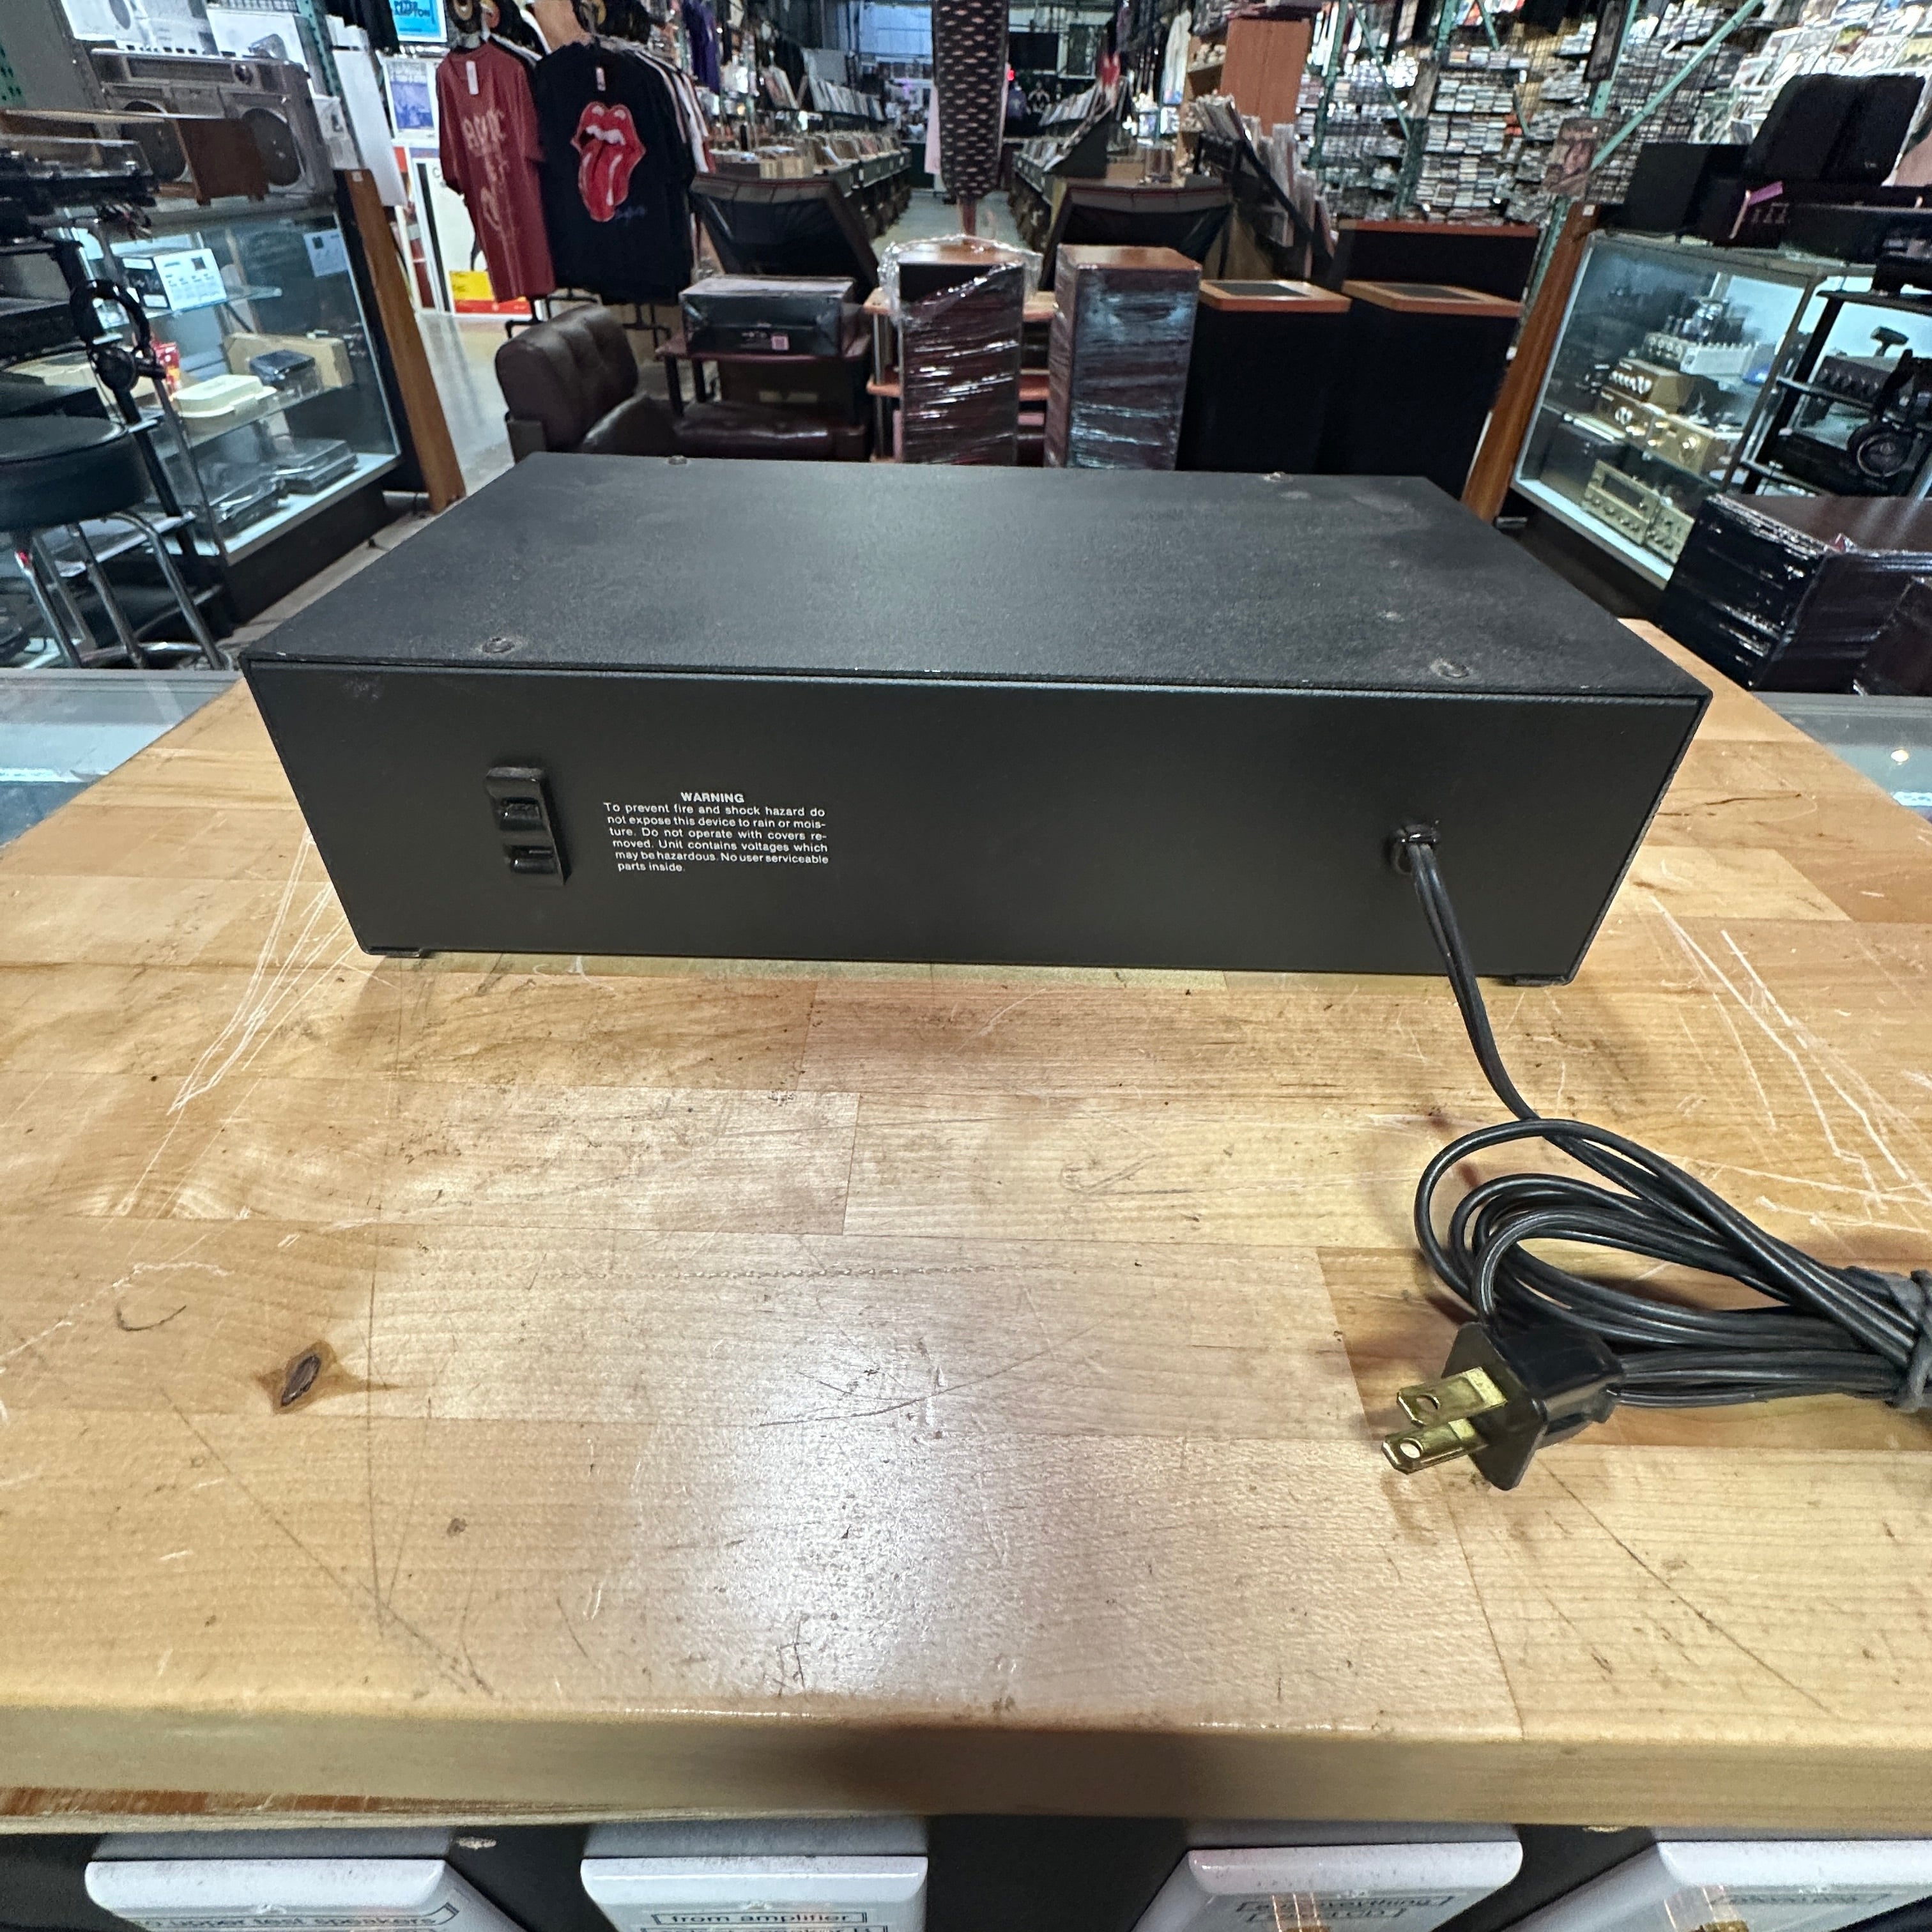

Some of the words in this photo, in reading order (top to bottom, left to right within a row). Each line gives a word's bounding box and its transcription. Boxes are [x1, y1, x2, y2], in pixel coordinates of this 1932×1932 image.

[680, 792, 745, 803] WARNING
[603, 802, 620, 811] To
[625, 804, 670, 813] prevent
[673, 804, 694, 813] fire
[698, 805, 720, 814] and
[726, 806, 760, 815] shock
[765, 806, 805, 816] hazard
[810, 808, 825, 817] do
[607, 816, 626, 824] not
[629, 816, 671, 825] expose
[673, 816, 695, 825] this
[698, 818, 736, 827] device
[739, 818, 750, 827] to
[753, 818, 775, 827] rain
[793, 820, 826, 829] mois-
[641, 827, 659, 837] Do
[664, 829, 683, 837] not
[688, 829, 733, 839] operate
[738, 830, 762, 839] with
[767, 832, 806, 840] covers
[658, 839, 683, 848] Unit
[687, 841, 737, 850] contains
[741, 841, 789, 853] voltages
[793, 843, 828, 852] which
[615, 851, 638, 861] may
[641, 851, 655, 860] be
[721, 853, 737, 861] No
[765, 854, 829, 864] serviceable
[617, 862, 646, 872] parts
[741, 1914, 848, 1922] amplifier
